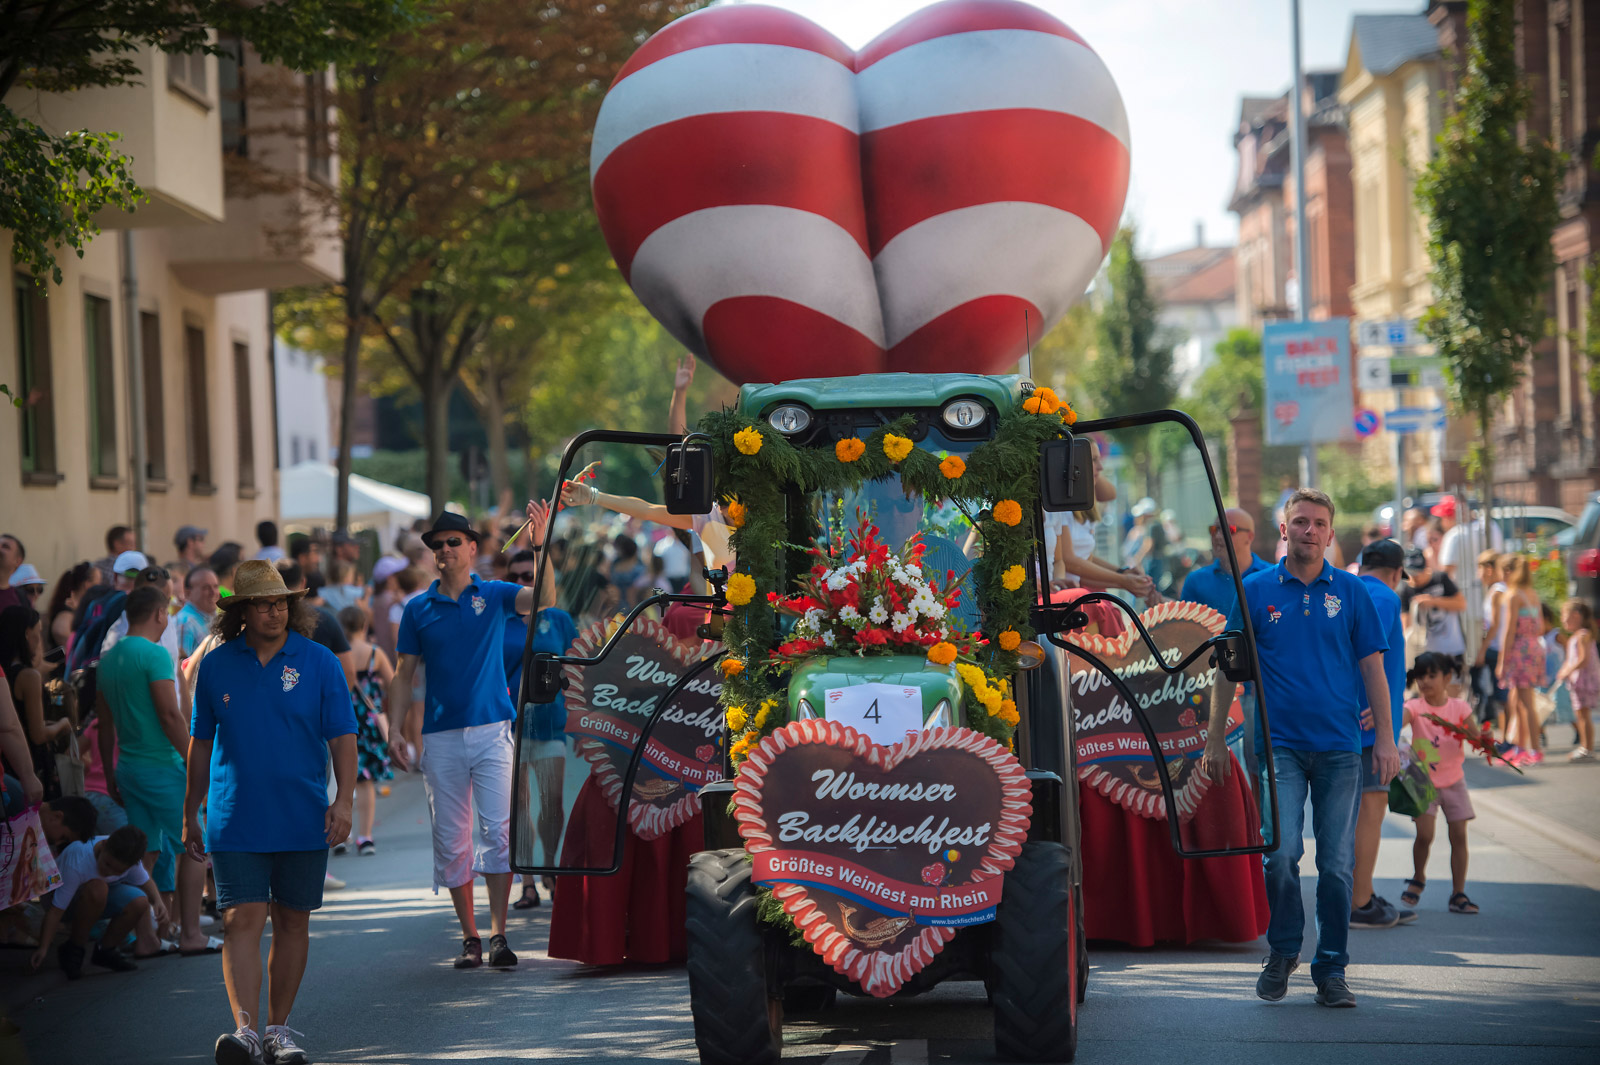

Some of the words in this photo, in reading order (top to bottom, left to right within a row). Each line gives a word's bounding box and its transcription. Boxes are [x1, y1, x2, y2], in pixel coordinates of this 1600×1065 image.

[626, 655, 723, 697] Wormse
[863, 698, 882, 724] 4
[580, 716, 629, 740] Größtes
[682, 766, 702, 779] am
[1178, 735, 1198, 748] am
[811, 768, 957, 801] Wormser
[777, 811, 991, 854] Backfischfest
[769, 857, 834, 877] Größtes
[839, 866, 906, 905] Weinfest
[909, 894, 935, 909] am
[940, 890, 988, 909] Rhein
[931, 913, 994, 925] www.backfischfest.de
